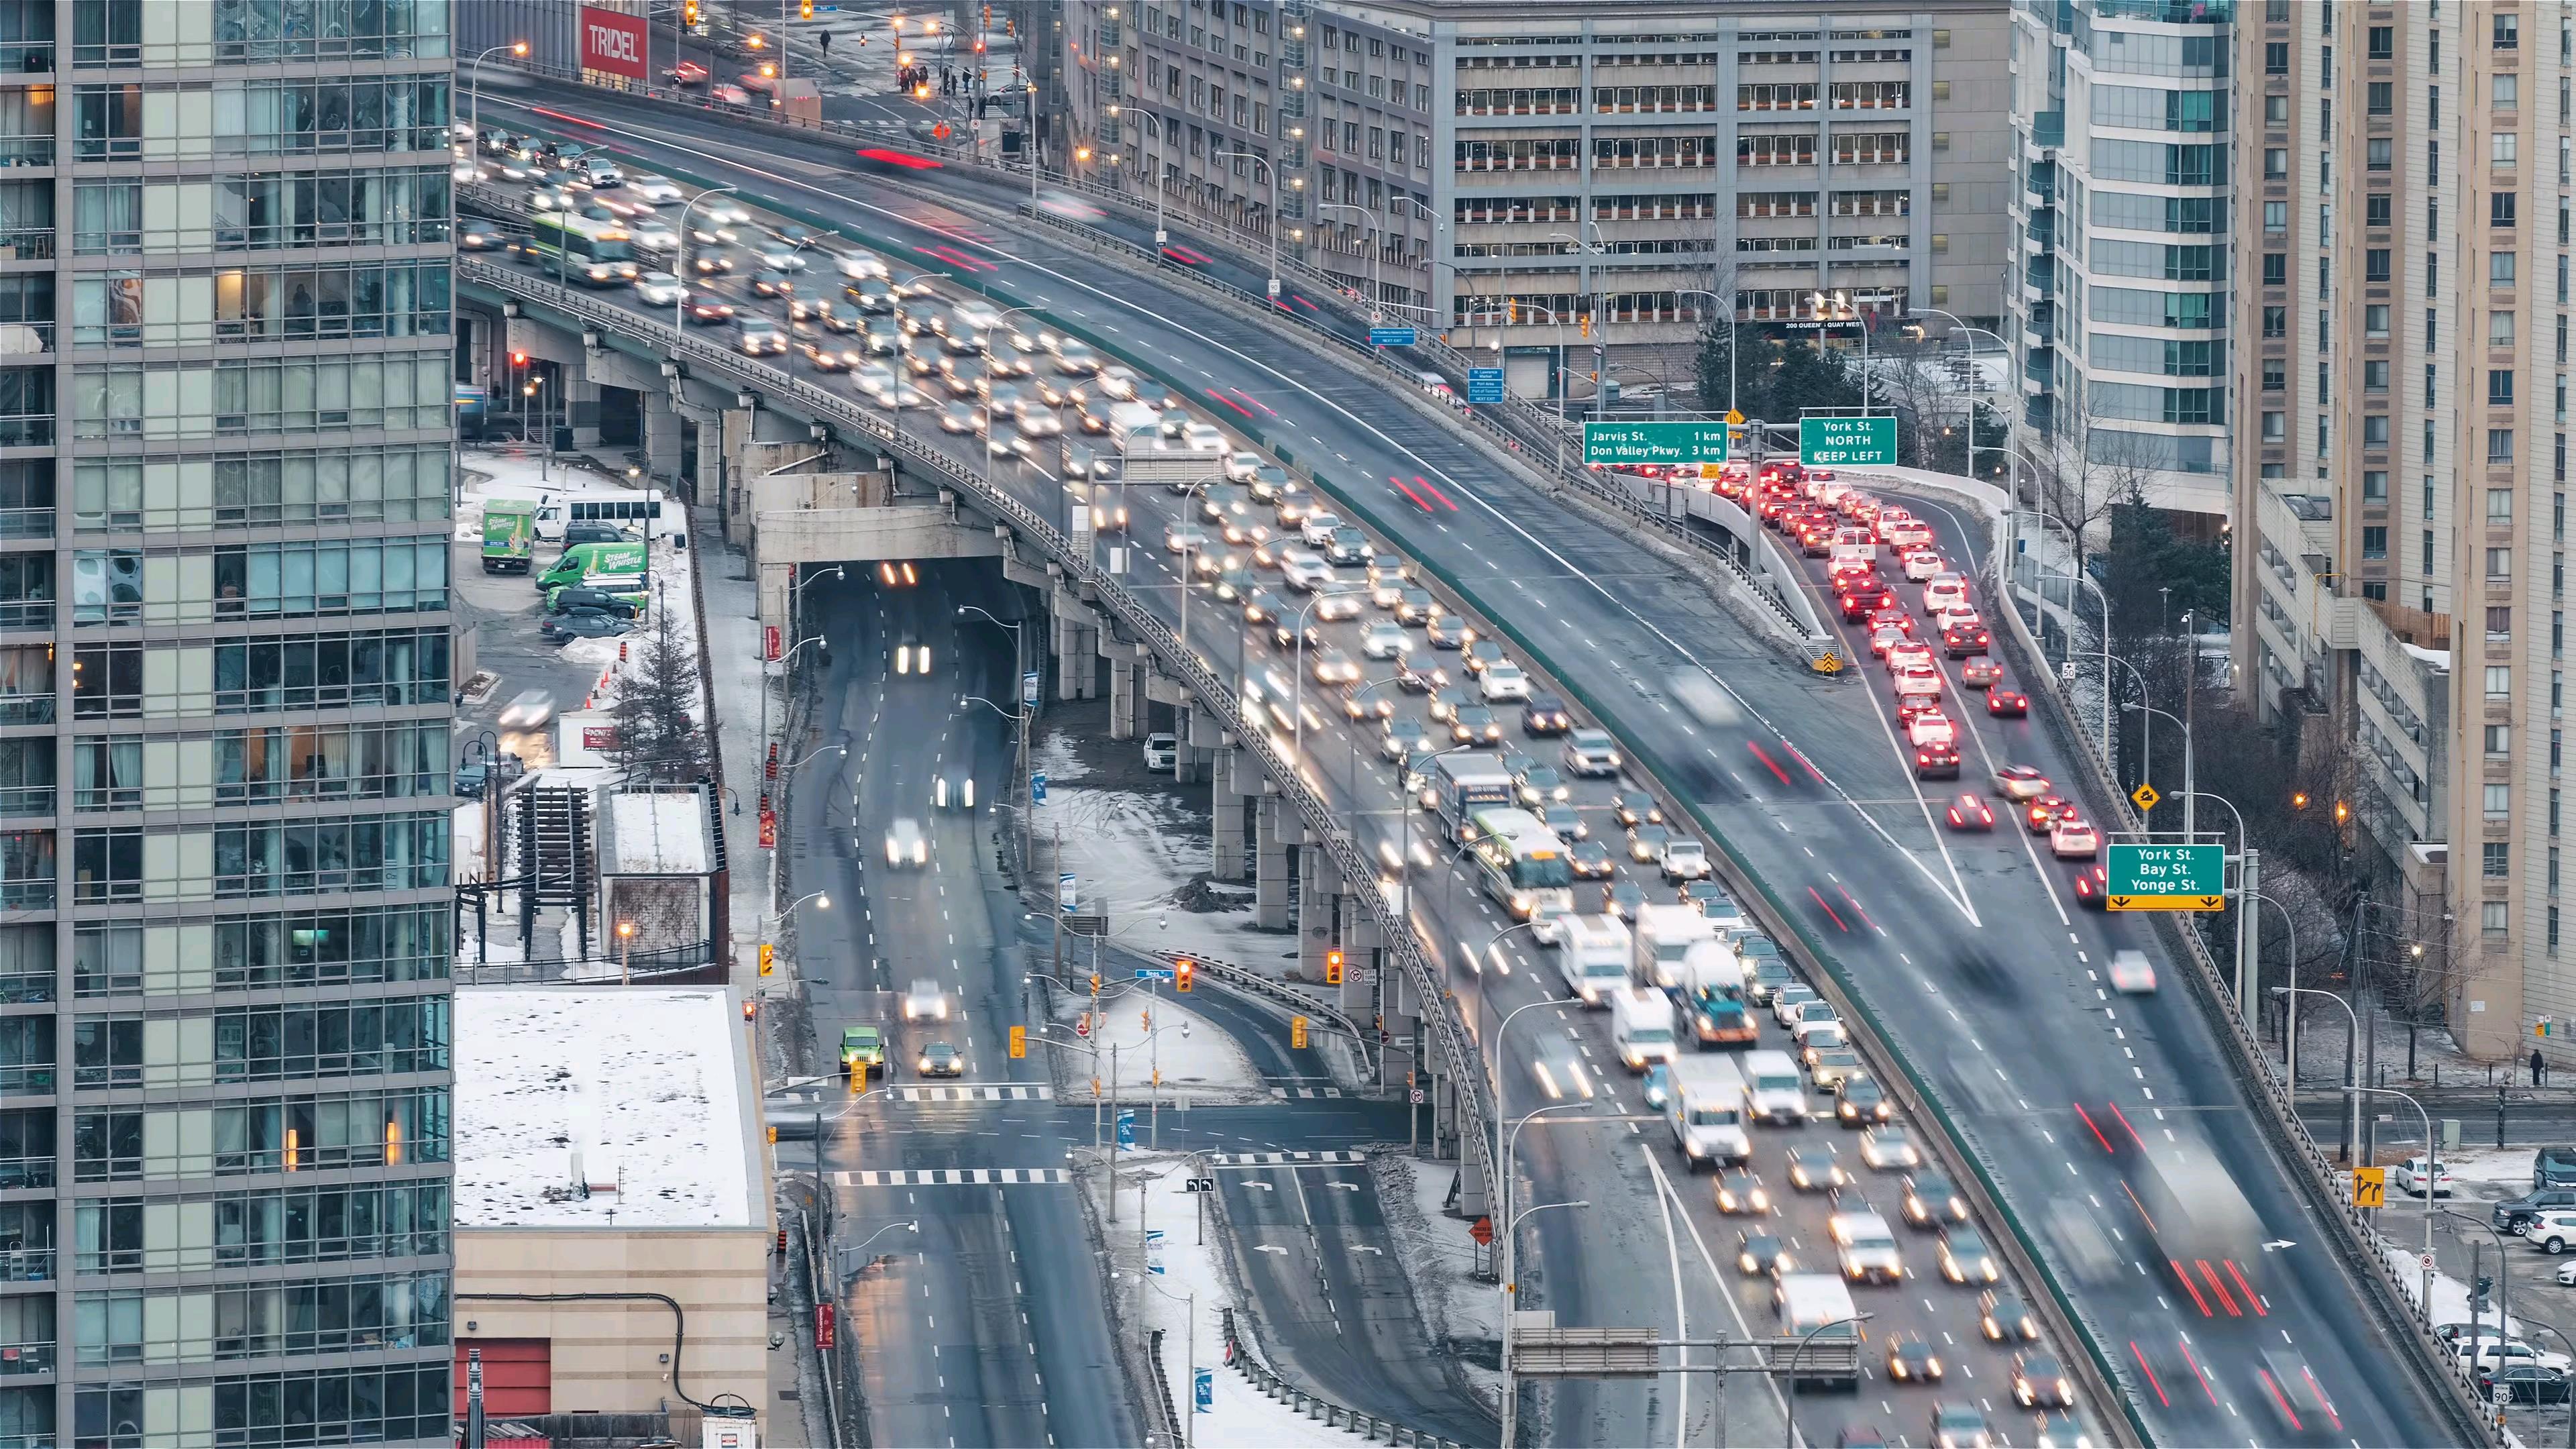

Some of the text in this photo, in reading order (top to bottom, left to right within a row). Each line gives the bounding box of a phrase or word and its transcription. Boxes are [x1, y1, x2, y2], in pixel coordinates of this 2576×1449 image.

[589, 24, 639, 63] TRIDEL
[1823, 422, 1874, 431] York St.
[1592, 431, 1720, 441] Jarvis St. 1 km
[1825, 435, 1871, 445] NORTH
[1591, 445, 1720, 458] Don Valley Pkwy. 3 km
[1814, 451, 1882, 462] KEEP LEFT
[490, 521, 515, 531] WHISTLE
[604, 551, 630, 563] STEAM
[608, 555, 643, 570] WHISTLE
[2138, 849, 2194, 860] York St.
[2140, 863, 2191, 877] Bay St.
[2131, 879, 2200, 894] Yonge St.
[2495, 1393, 2508, 1402] 90
